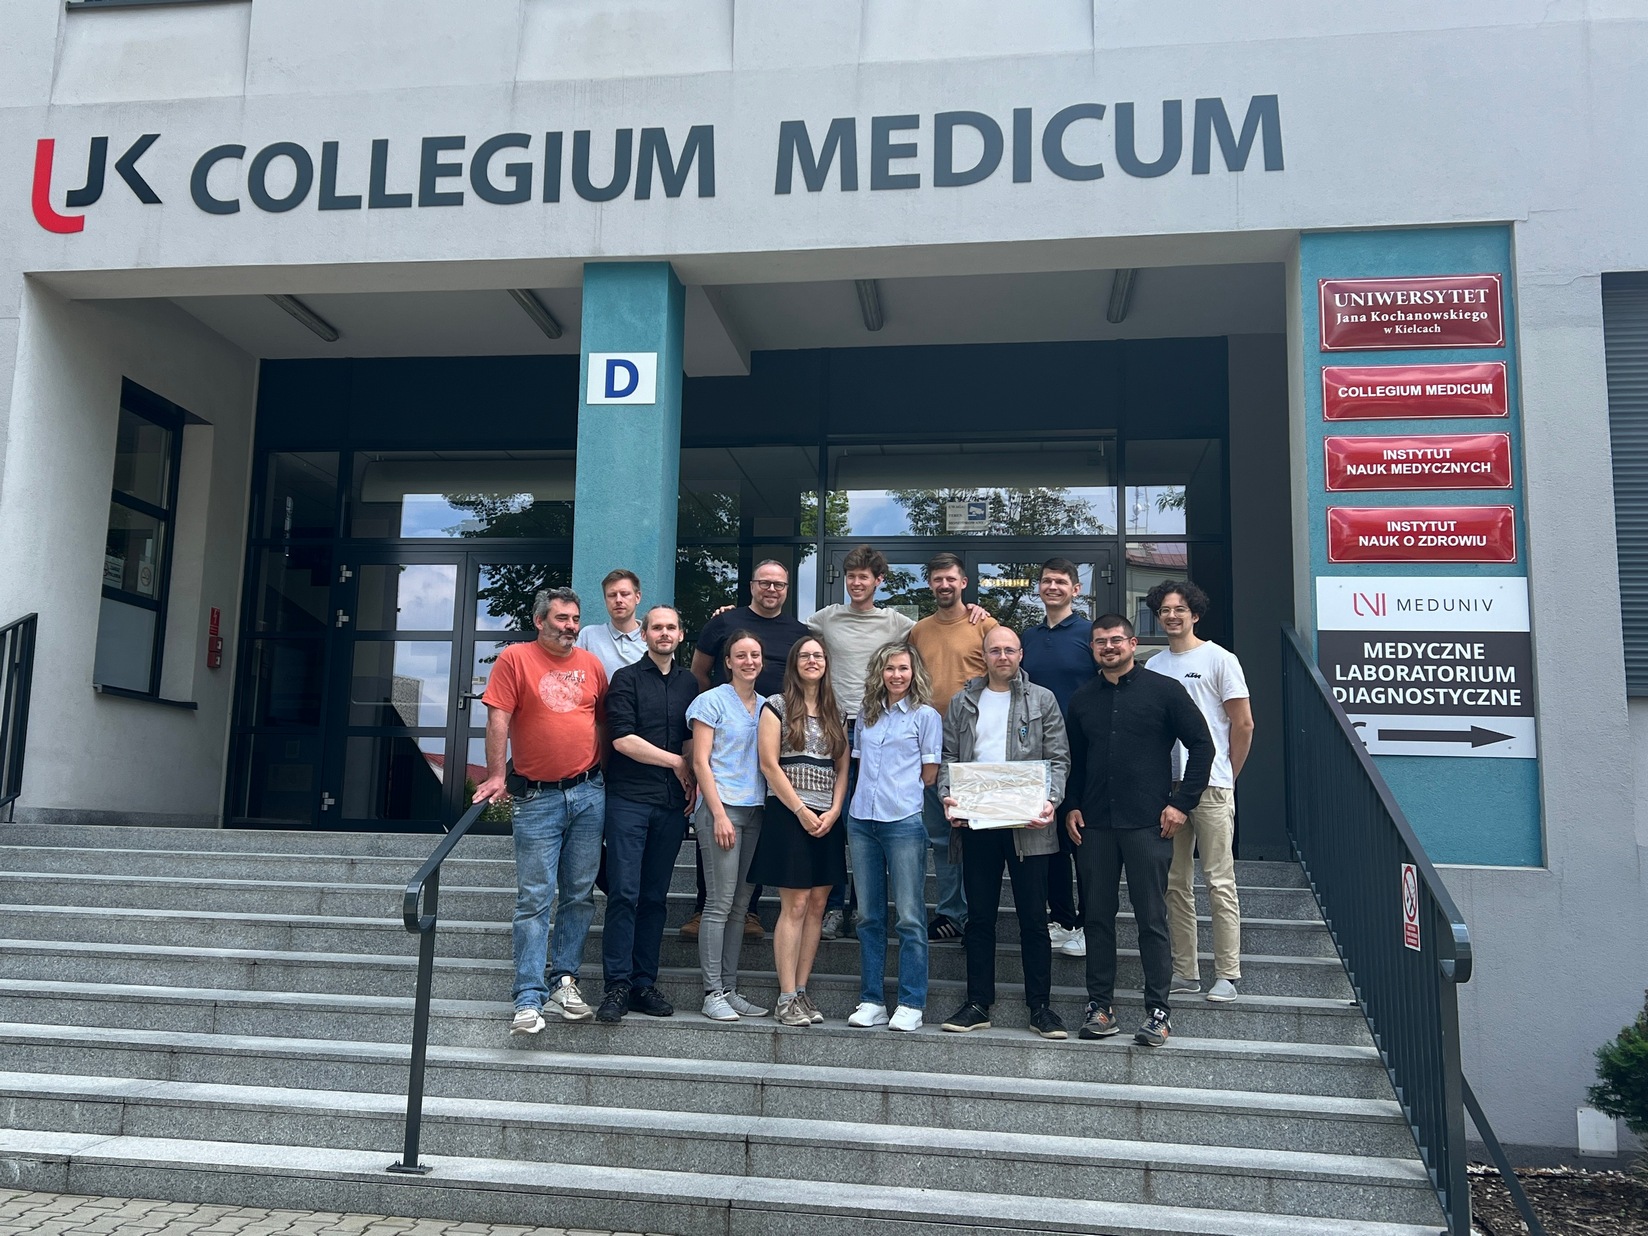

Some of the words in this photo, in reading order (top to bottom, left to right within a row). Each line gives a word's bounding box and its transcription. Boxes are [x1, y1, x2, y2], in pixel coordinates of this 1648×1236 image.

[190, 125, 716, 215] COLLEGIUM
[774, 94, 1285, 195] MEDICUM
[1334, 288, 1489, 308] UNIWERSYTET
[1336, 312, 1367, 325] Jana
[1371, 308, 1488, 323] Kochanowskiego
[1395, 324, 1441, 334] Kielcach
[604, 358, 640, 399] D
[1338, 385, 1422, 398] COLLEGIUM
[1425, 383, 1493, 396] MEDICUM
[1383, 448, 1452, 460] INSTYTUT
[1346, 463, 1387, 475] NAUK
[1391, 461, 1491, 474] MEDYCZNYCH
[1386, 521, 1457, 532] INSTYTUT
[1359, 536, 1399, 547] NAUK
[1403, 535, 1415, 547] O
[1418, 534, 1487, 547] ZDROWIU
[1397, 598, 1494, 612] MEDUNIV
[1363, 642, 1485, 660] MEDYCZNE
[1335, 664, 1516, 683] LABORATORIUM
[1332, 687, 1522, 706] DIAGNOSTYCZNE
